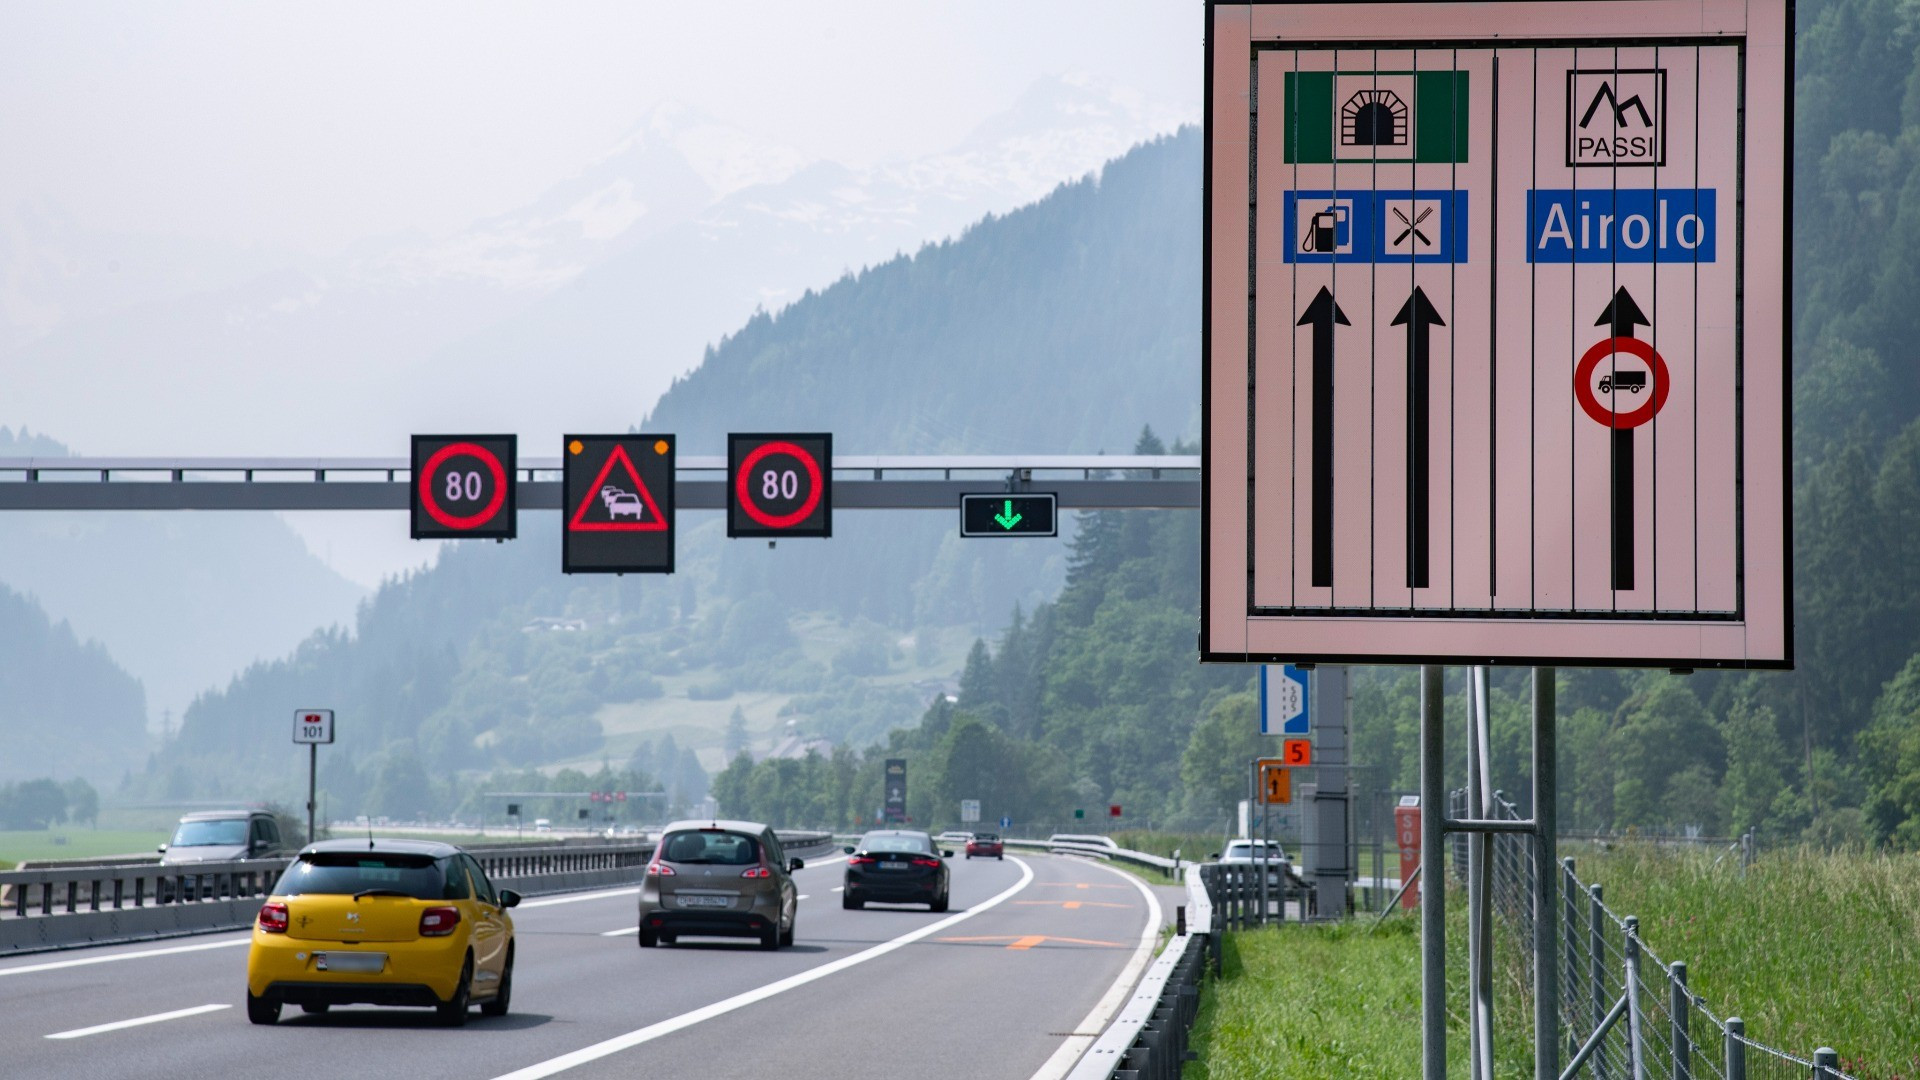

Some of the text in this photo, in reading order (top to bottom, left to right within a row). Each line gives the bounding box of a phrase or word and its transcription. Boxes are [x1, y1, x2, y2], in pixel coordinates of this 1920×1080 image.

[1578, 137, 1653, 158] PASSI
[1538, 199, 1705, 250] Airolo
[445, 471, 482, 502] 80
[762, 470, 798, 501] 80
[1290, 686, 1298, 712] SOS
[303, 726, 323, 738] 101
[1292, 744, 1303, 763] 5
[1402, 815, 1413, 861] SOS
